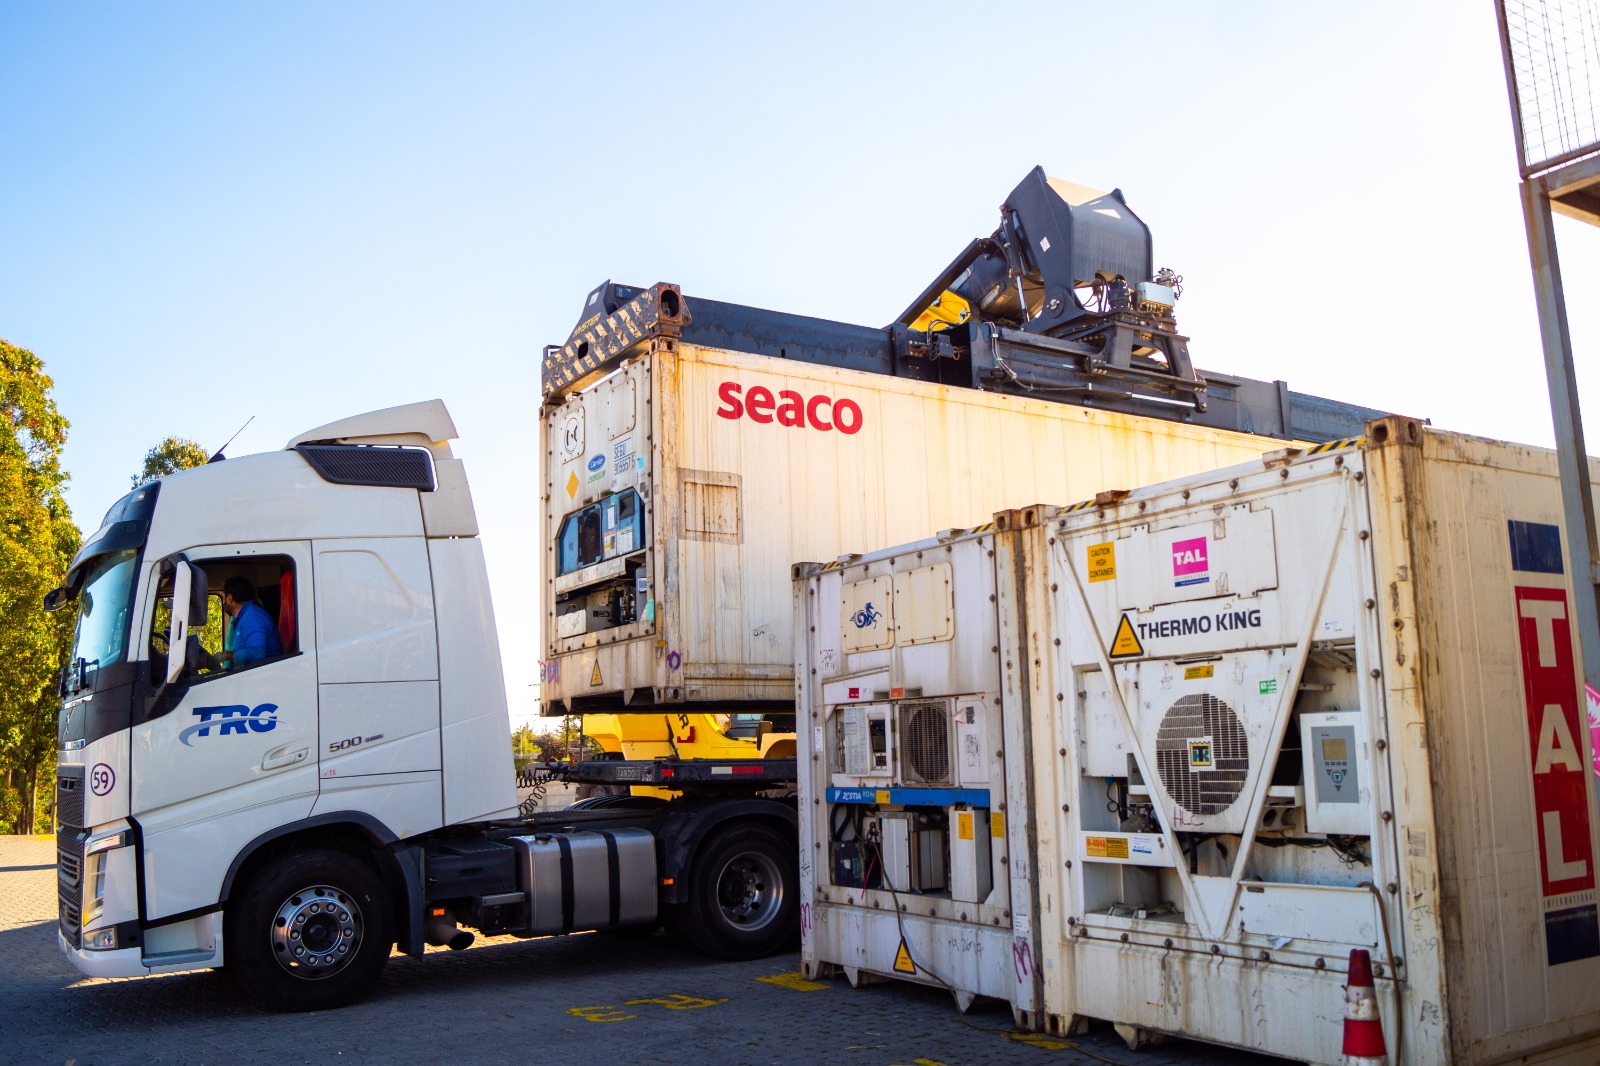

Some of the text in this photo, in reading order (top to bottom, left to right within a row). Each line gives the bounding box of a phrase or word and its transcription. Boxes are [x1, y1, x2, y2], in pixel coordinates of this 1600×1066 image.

[716, 381, 863, 435] seaco
[1091, 547, 1111, 557] CAUTION
[1173, 549, 1206, 566] TAL
[1095, 559, 1107, 567] HIGH
[1089, 568, 1115, 578] CONTAINER
[1137, 609, 1262, 640] THERMO KING
[192, 702, 279, 737] TRG
[329, 736, 362, 753] 500
[1519, 599, 1588, 883] TAL
[93, 771, 109, 790] 59
